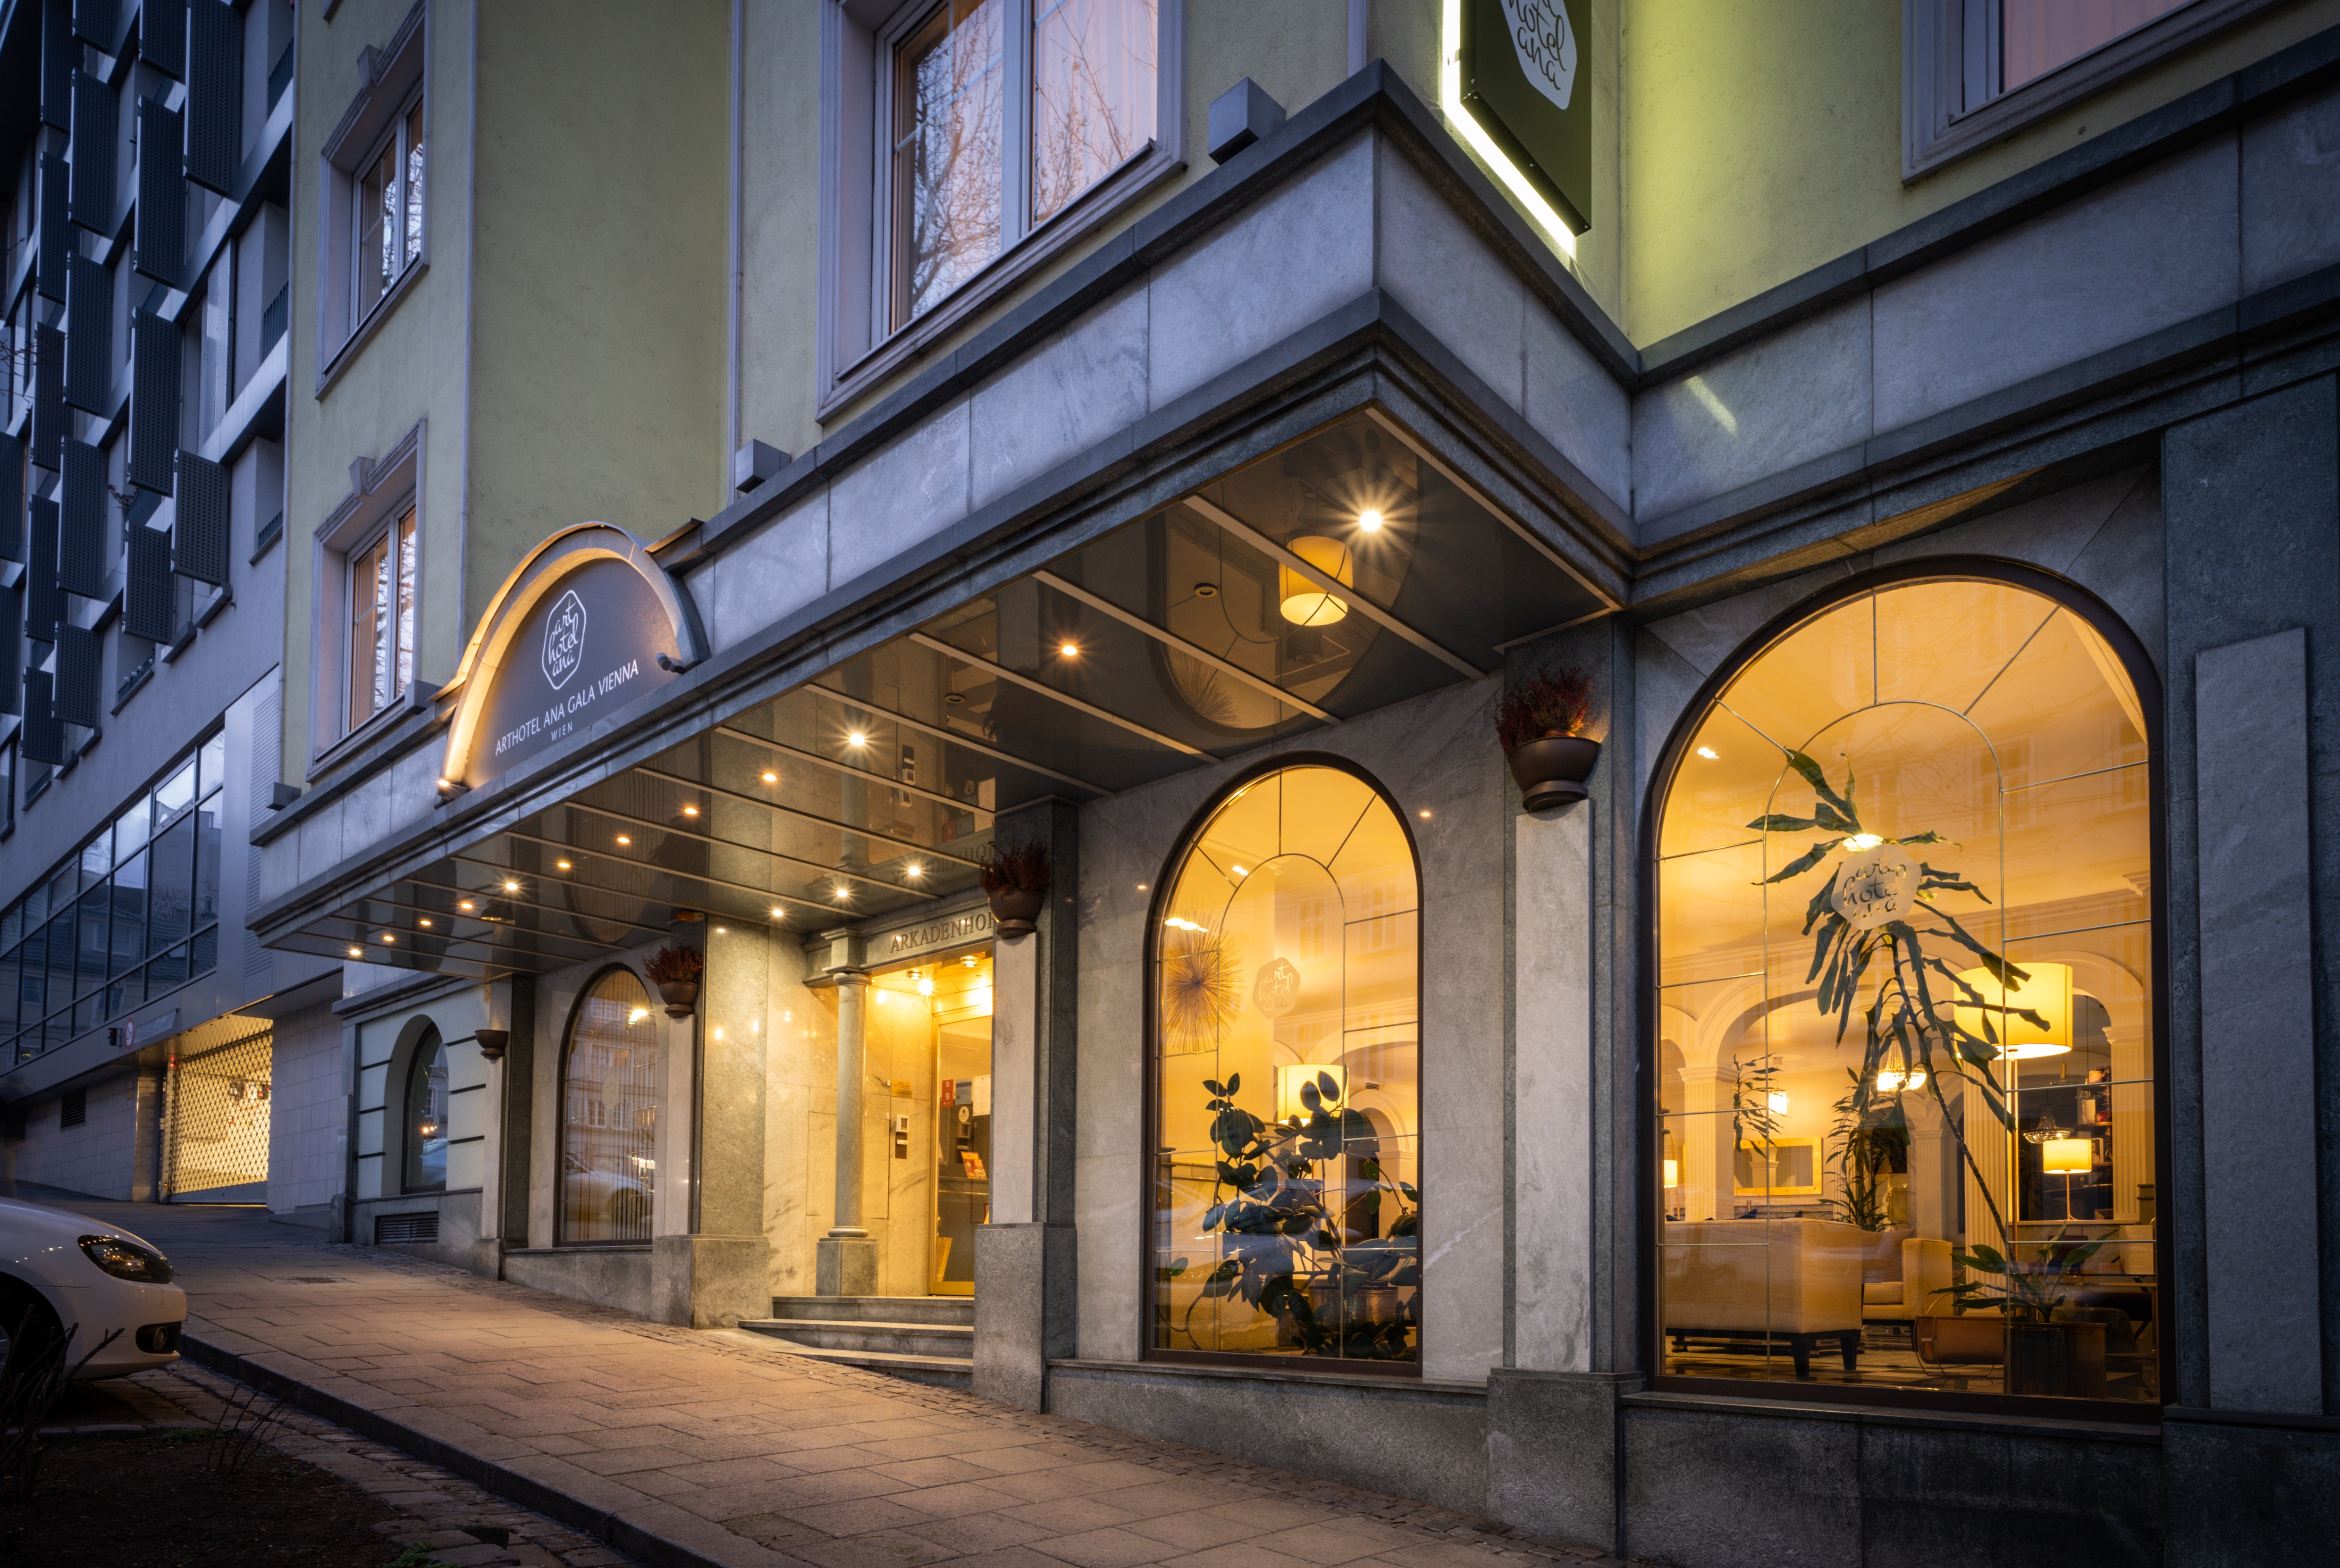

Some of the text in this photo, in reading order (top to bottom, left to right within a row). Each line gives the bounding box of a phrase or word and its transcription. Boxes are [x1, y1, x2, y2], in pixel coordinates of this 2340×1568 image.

[1509, 0, 1567, 72] otel
[1517, 26, 1561, 91] ana
[555, 597, 577, 635] art
[548, 612, 579, 665] hotel
[552, 650, 575, 677] ana
[495, 659, 639, 756] ARTHOTEL ANA GALA VIENNA
[551, 721, 572, 741] WIEN
[1855, 850, 1901, 880] art
[1843, 864, 1910, 907] hotel
[1853, 898, 1902, 919] ana
[1265, 960, 1290, 983] art
[1258, 973, 1293, 1003] hotel
[945, 1092, 950, 1100] 9
